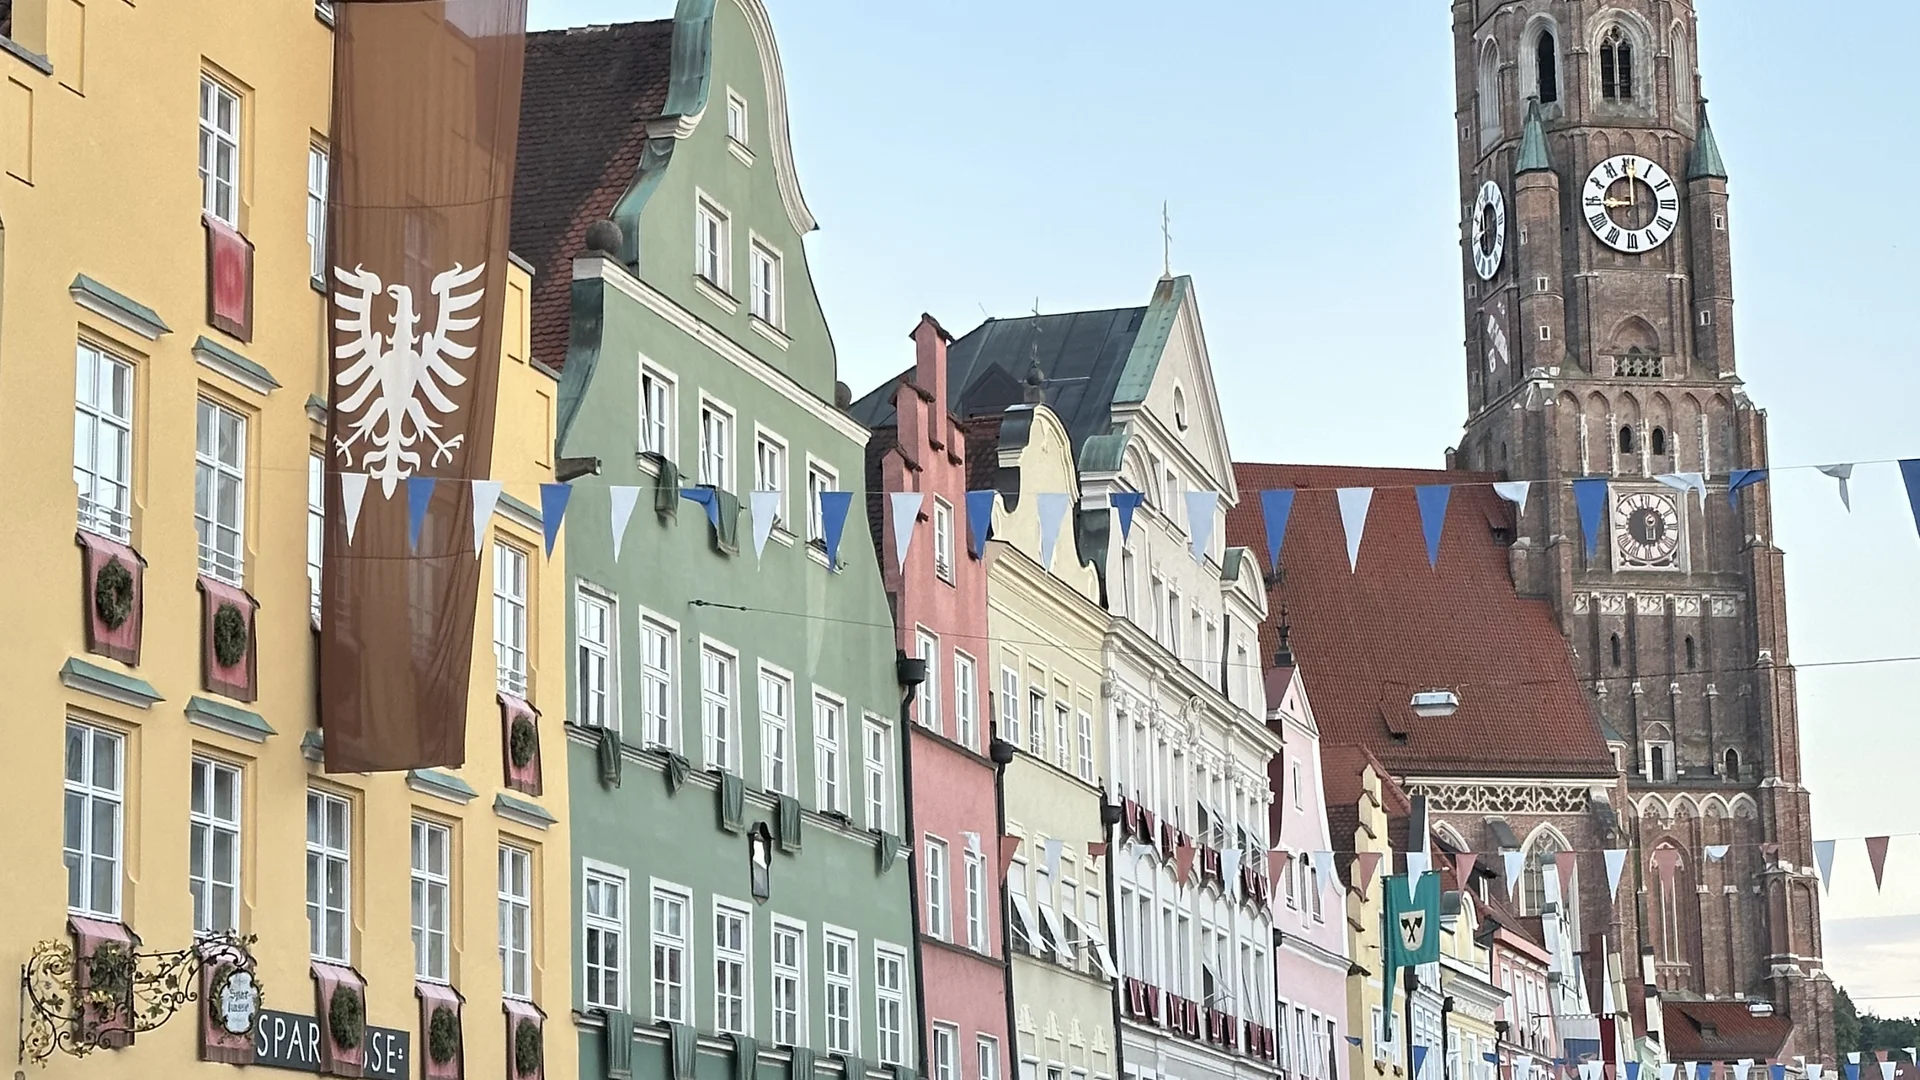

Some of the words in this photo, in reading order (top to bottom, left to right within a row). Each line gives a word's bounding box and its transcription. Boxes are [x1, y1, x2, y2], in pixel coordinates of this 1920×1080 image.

[1643, 164, 1653, 178] I
[1654, 178, 1671, 192] II
[1660, 199, 1676, 210] III
